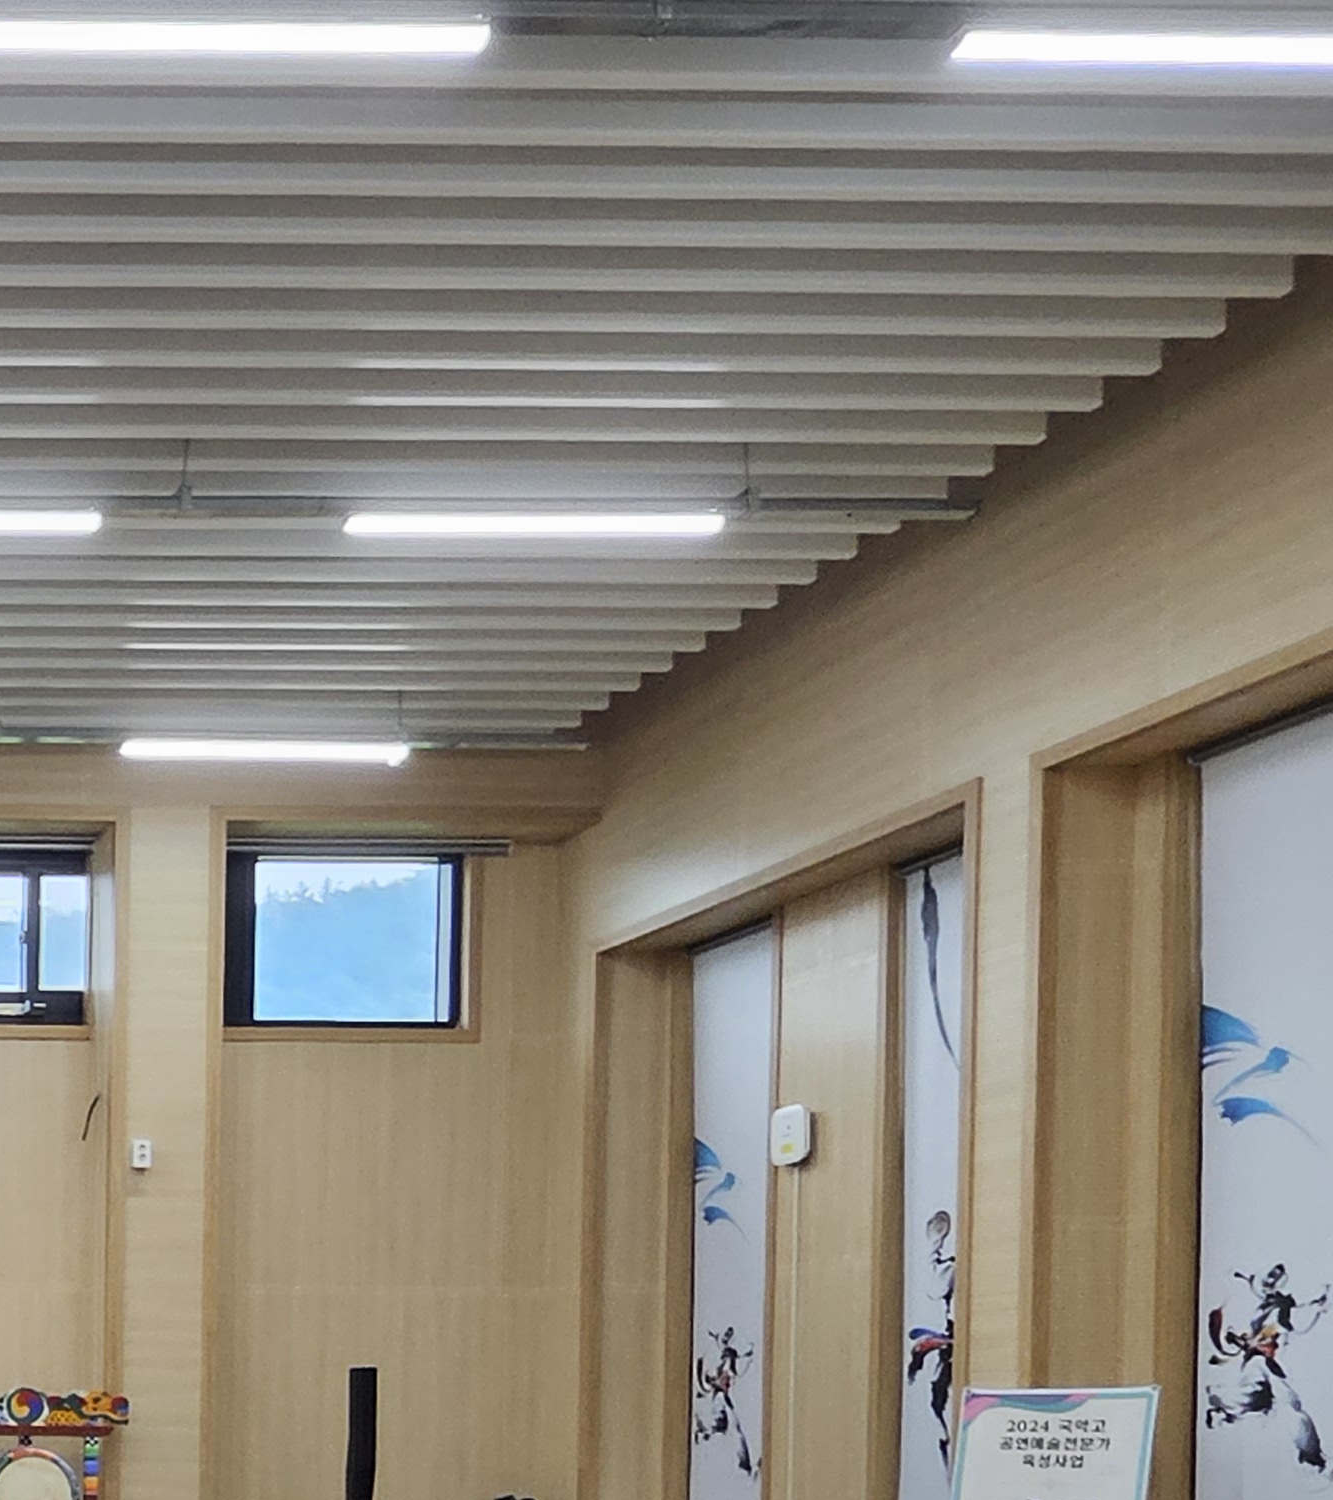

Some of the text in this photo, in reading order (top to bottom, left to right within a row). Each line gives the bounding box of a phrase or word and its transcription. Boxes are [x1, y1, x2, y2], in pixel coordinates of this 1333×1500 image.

[1006, 1419, 1107, 1433] 2024 국악고
[1022, 1454, 1084, 1469] 육성사업
